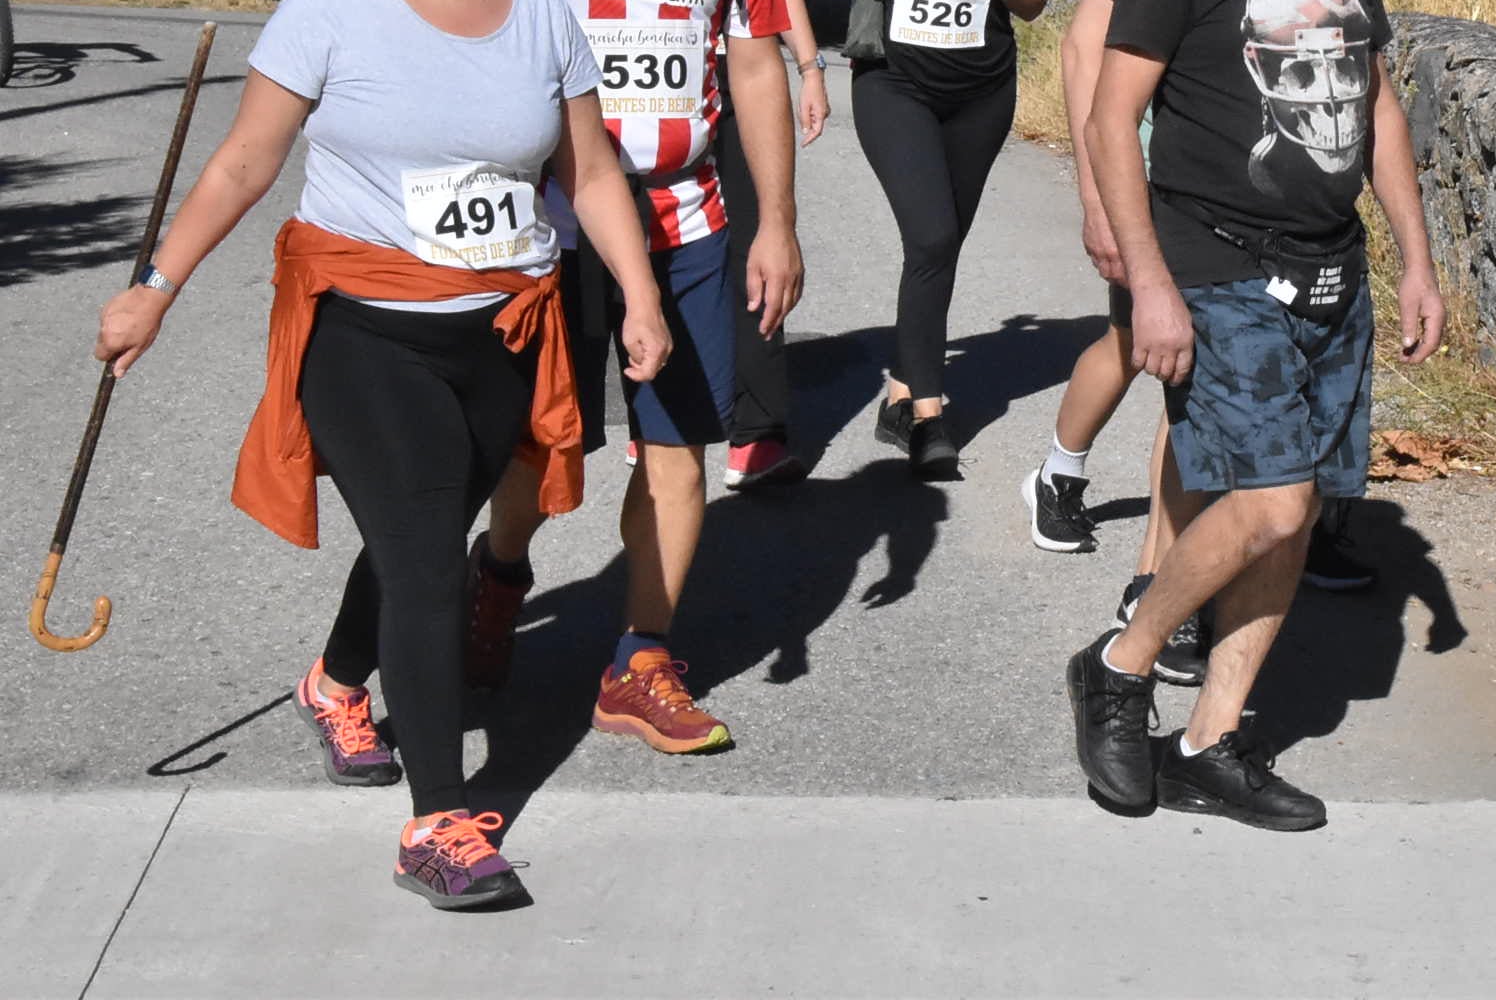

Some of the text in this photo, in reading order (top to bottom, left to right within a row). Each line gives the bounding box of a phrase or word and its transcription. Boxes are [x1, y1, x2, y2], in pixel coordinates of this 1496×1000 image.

[602, 54, 688, 90] 530
[600, 97, 646, 113] UENTES
[649, 97, 665, 113] DE
[435, 191, 519, 239] 491
[489, 241, 505, 260] DE
